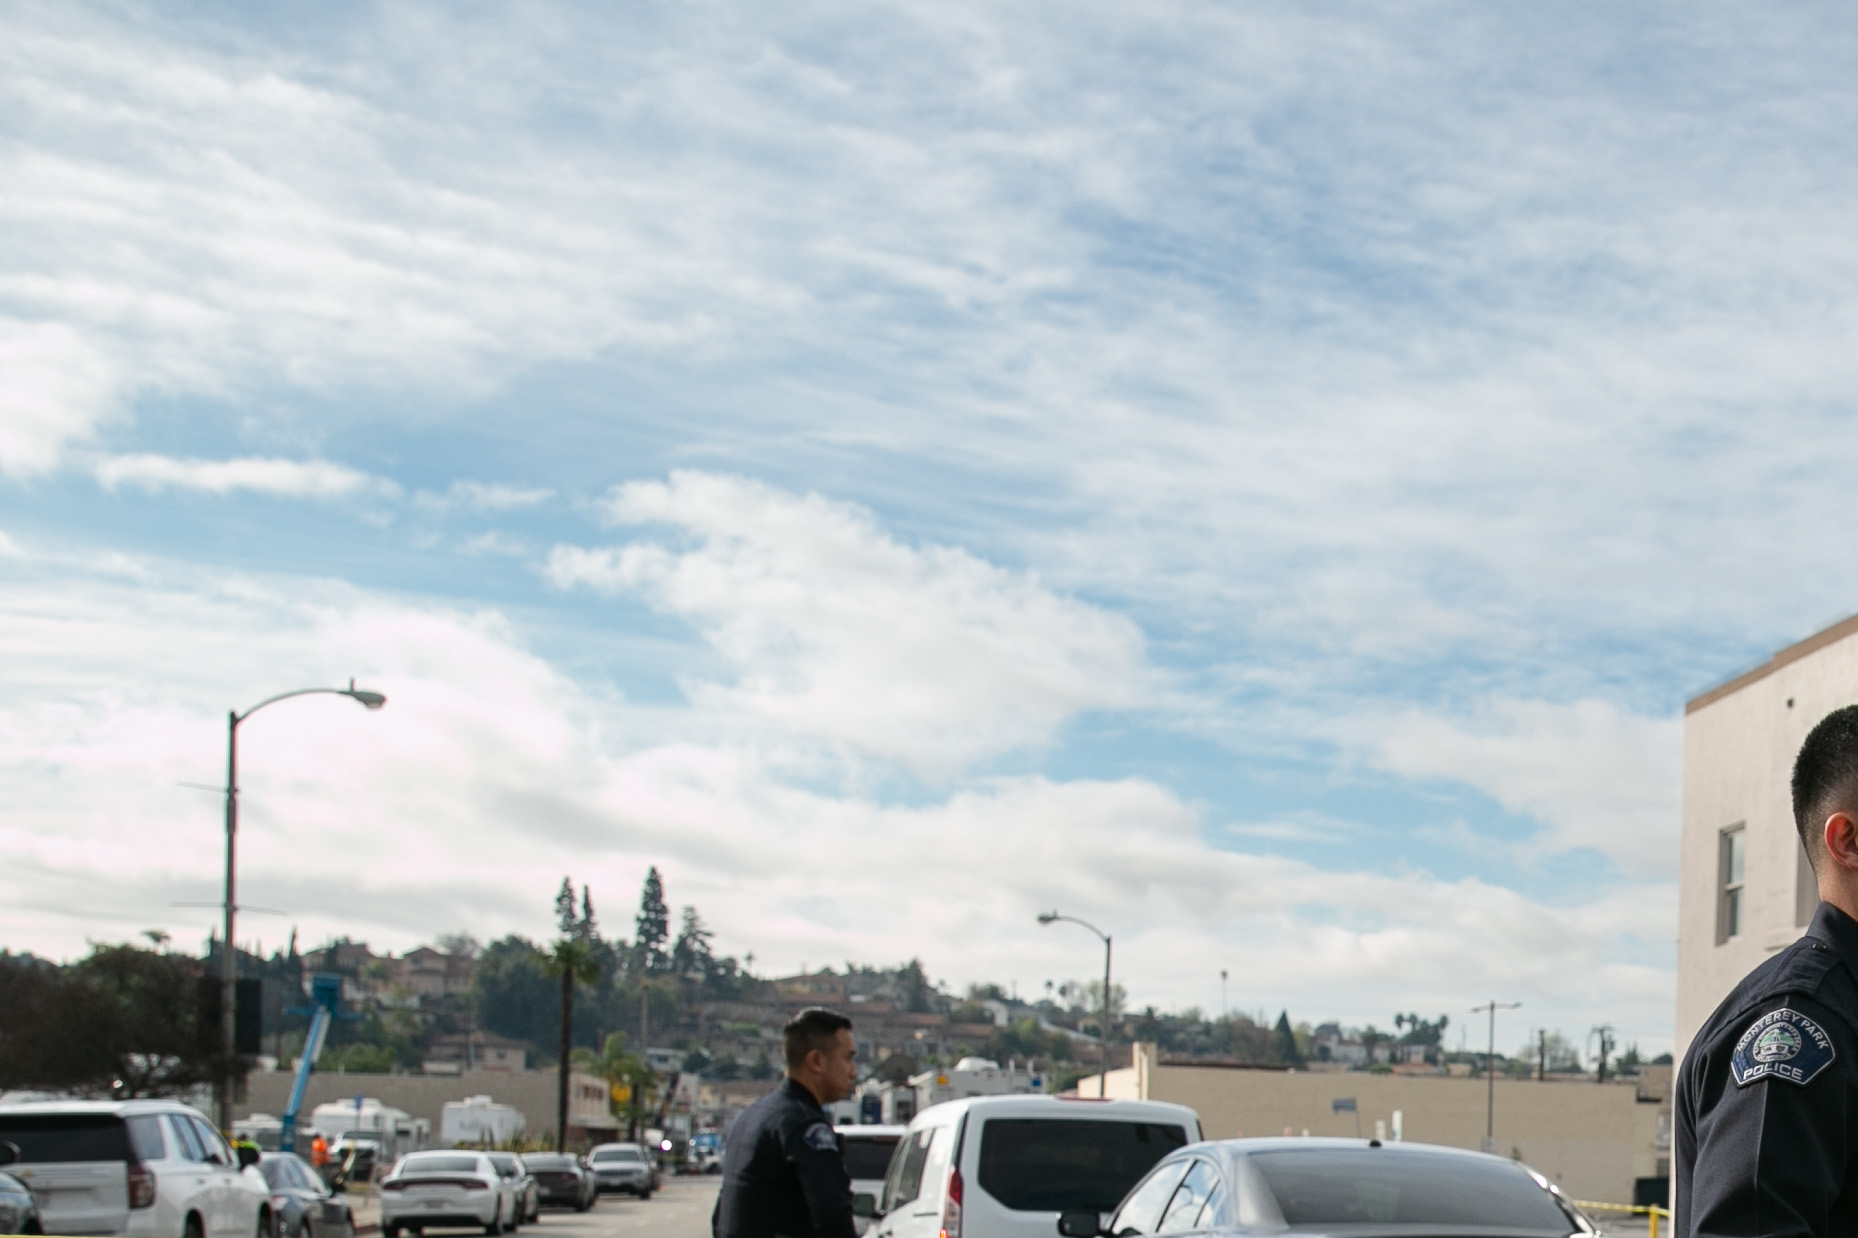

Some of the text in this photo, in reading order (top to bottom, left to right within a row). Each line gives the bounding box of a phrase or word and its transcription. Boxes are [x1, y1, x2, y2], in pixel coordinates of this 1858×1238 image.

[1736, 1010, 1801, 1051] MONTEREY
[1801, 1019, 1829, 1050] PARK
[1743, 1063, 1804, 1080] POLICE
